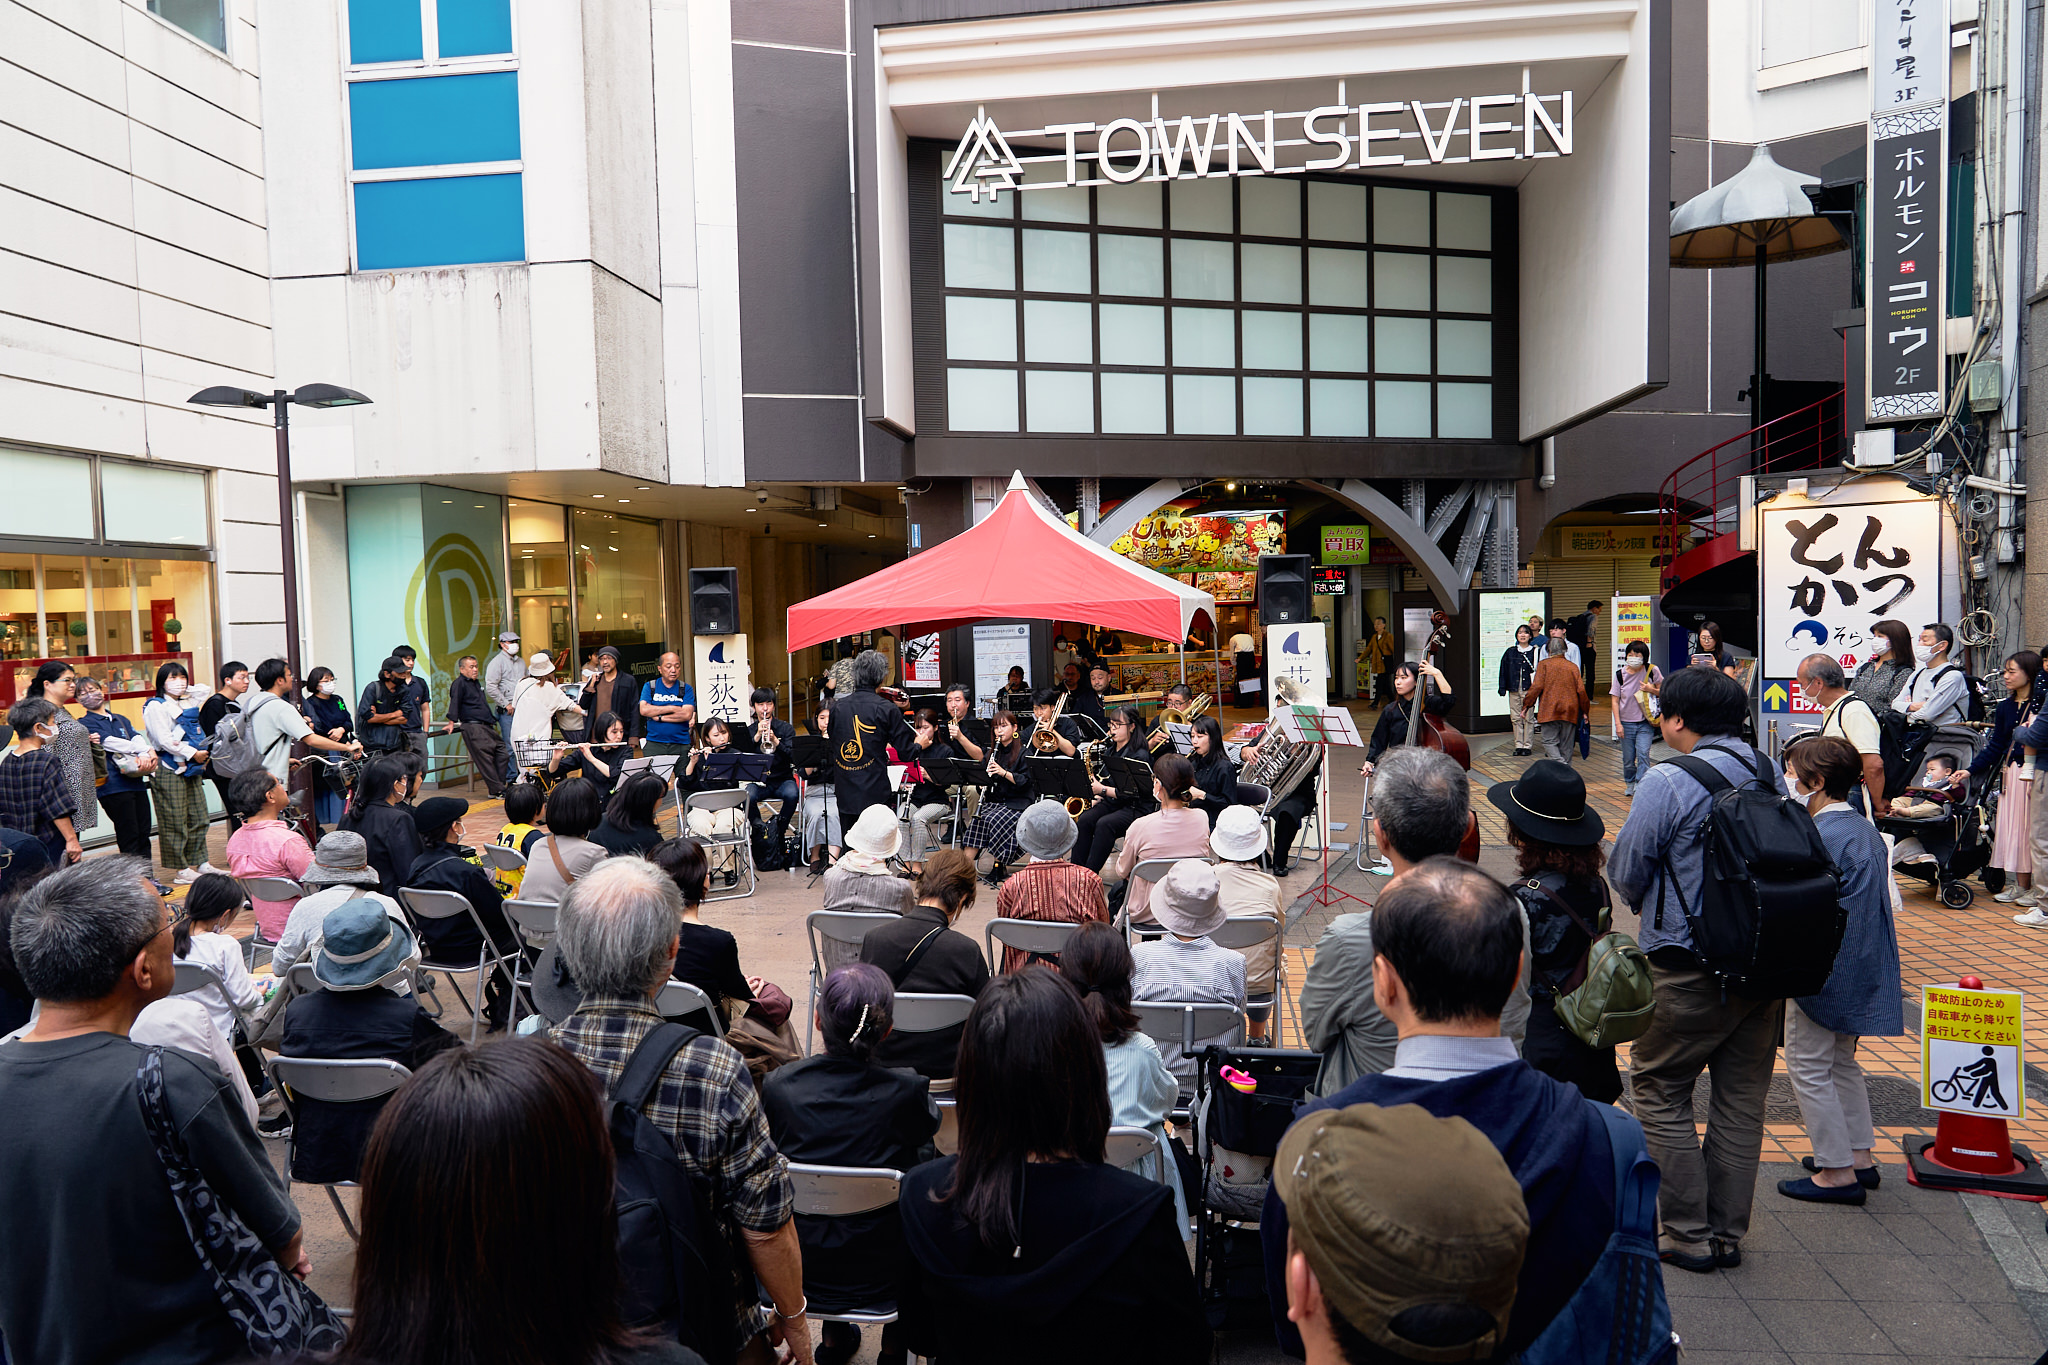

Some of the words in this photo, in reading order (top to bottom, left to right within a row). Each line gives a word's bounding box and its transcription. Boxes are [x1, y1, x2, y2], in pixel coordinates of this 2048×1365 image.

[1894, 86, 1918, 103] 3F
[1044, 110, 1275, 185] TOWN
[1303, 89, 1573, 171] SEVEN
[1893, 147, 1926, 254] ホルモン
[1890, 307, 1928, 316] HORUMON
[1895, 366, 1921, 385] 2F
[1326, 527, 1364, 537] みんなの
[1324, 537, 1365, 552] 買取
[1785, 513, 1911, 575] とん
[1787, 574, 1916, 617] かつ
[1792, 697, 1826, 711] ロッカ
[1927, 992, 2005, 1009] 事故防止のため
[1927, 1008, 2015, 1026] 自転車から降りて
[1926, 1024, 2016, 1042] 通行してください
